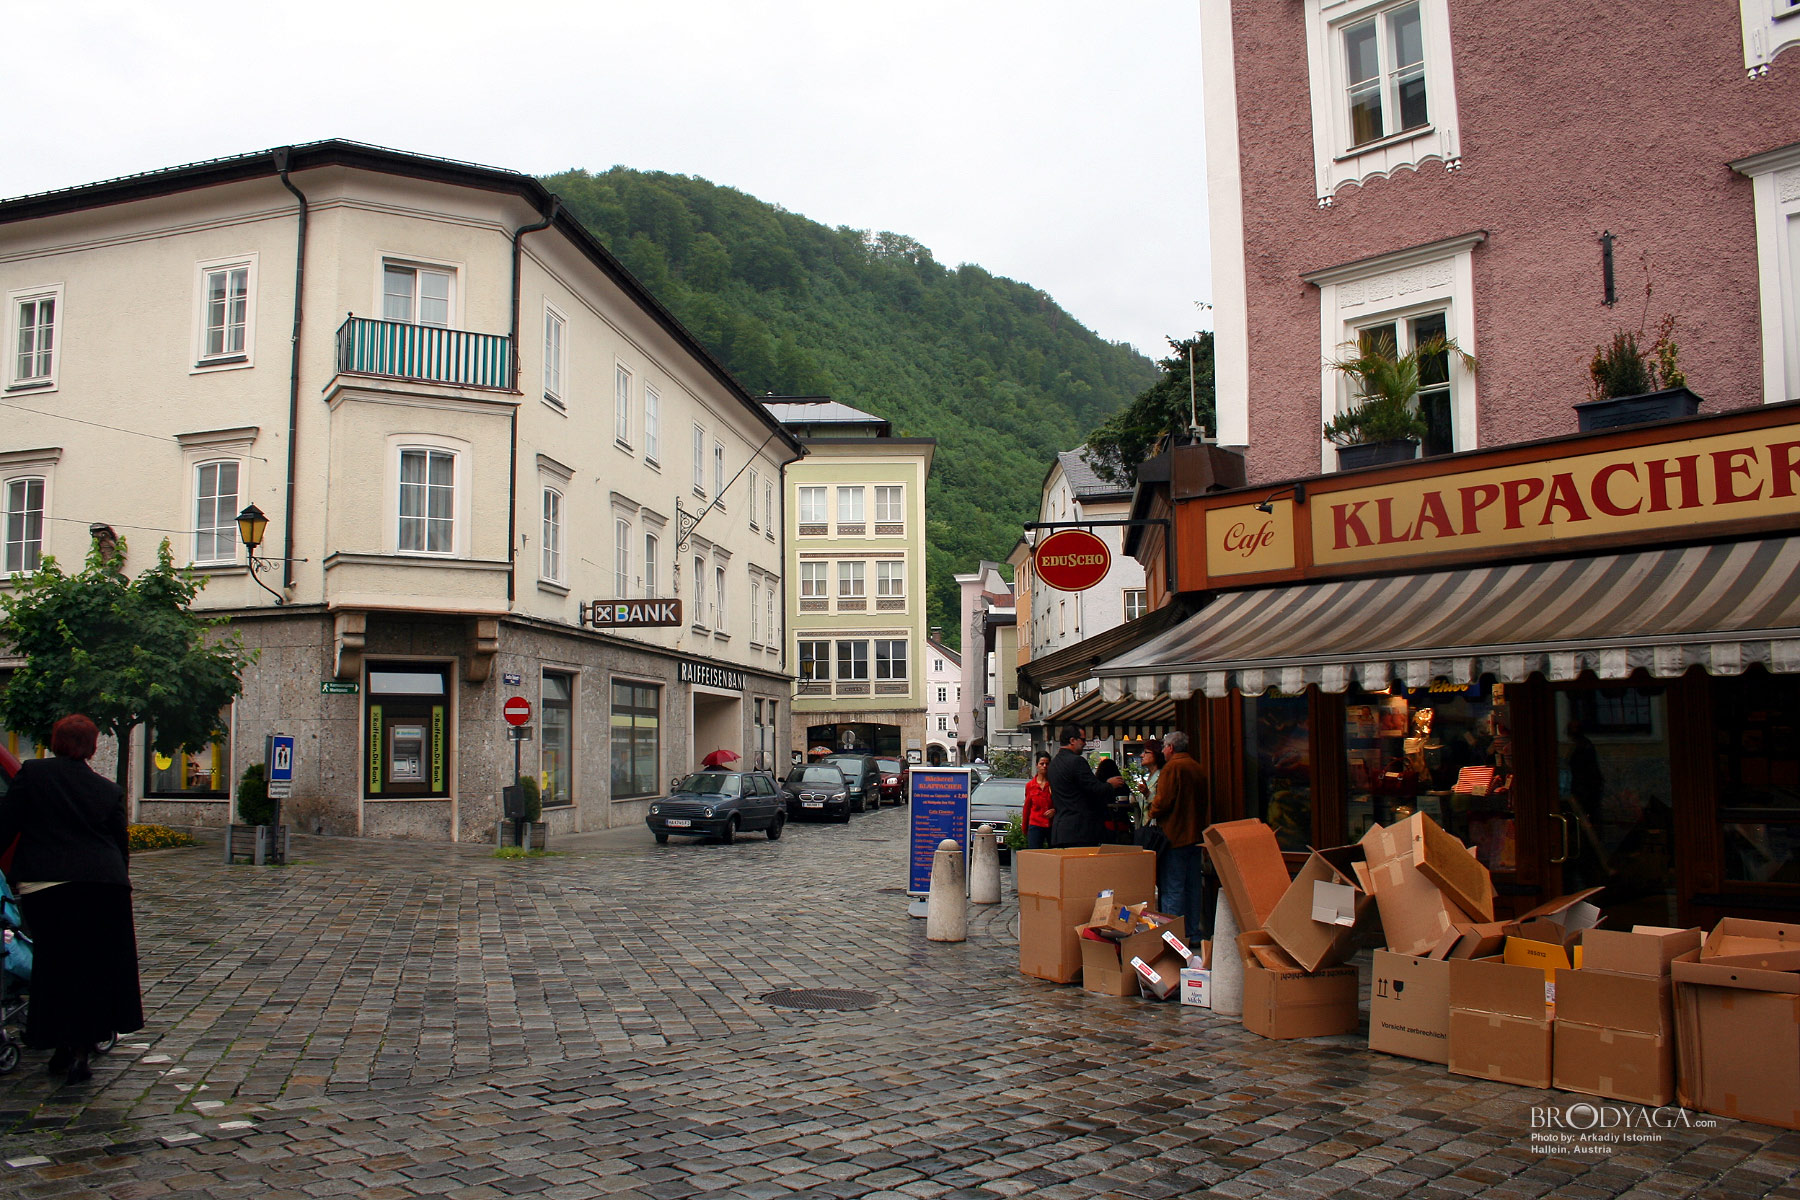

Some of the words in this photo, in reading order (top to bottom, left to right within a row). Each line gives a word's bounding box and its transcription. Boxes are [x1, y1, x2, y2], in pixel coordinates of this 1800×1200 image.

[1330, 441, 1800, 550] KLAPPACHER
[1223, 520, 1275, 557] Cafe
[1041, 554, 1104, 567] EDUSCHO
[615, 603, 677, 622] BANK
[681, 662, 747, 690] RAIFFEISENBANK
[1381, 1021, 1406, 1033] Vorsicht
[1406, 1027, 1447, 1039] zerbrechlich!
